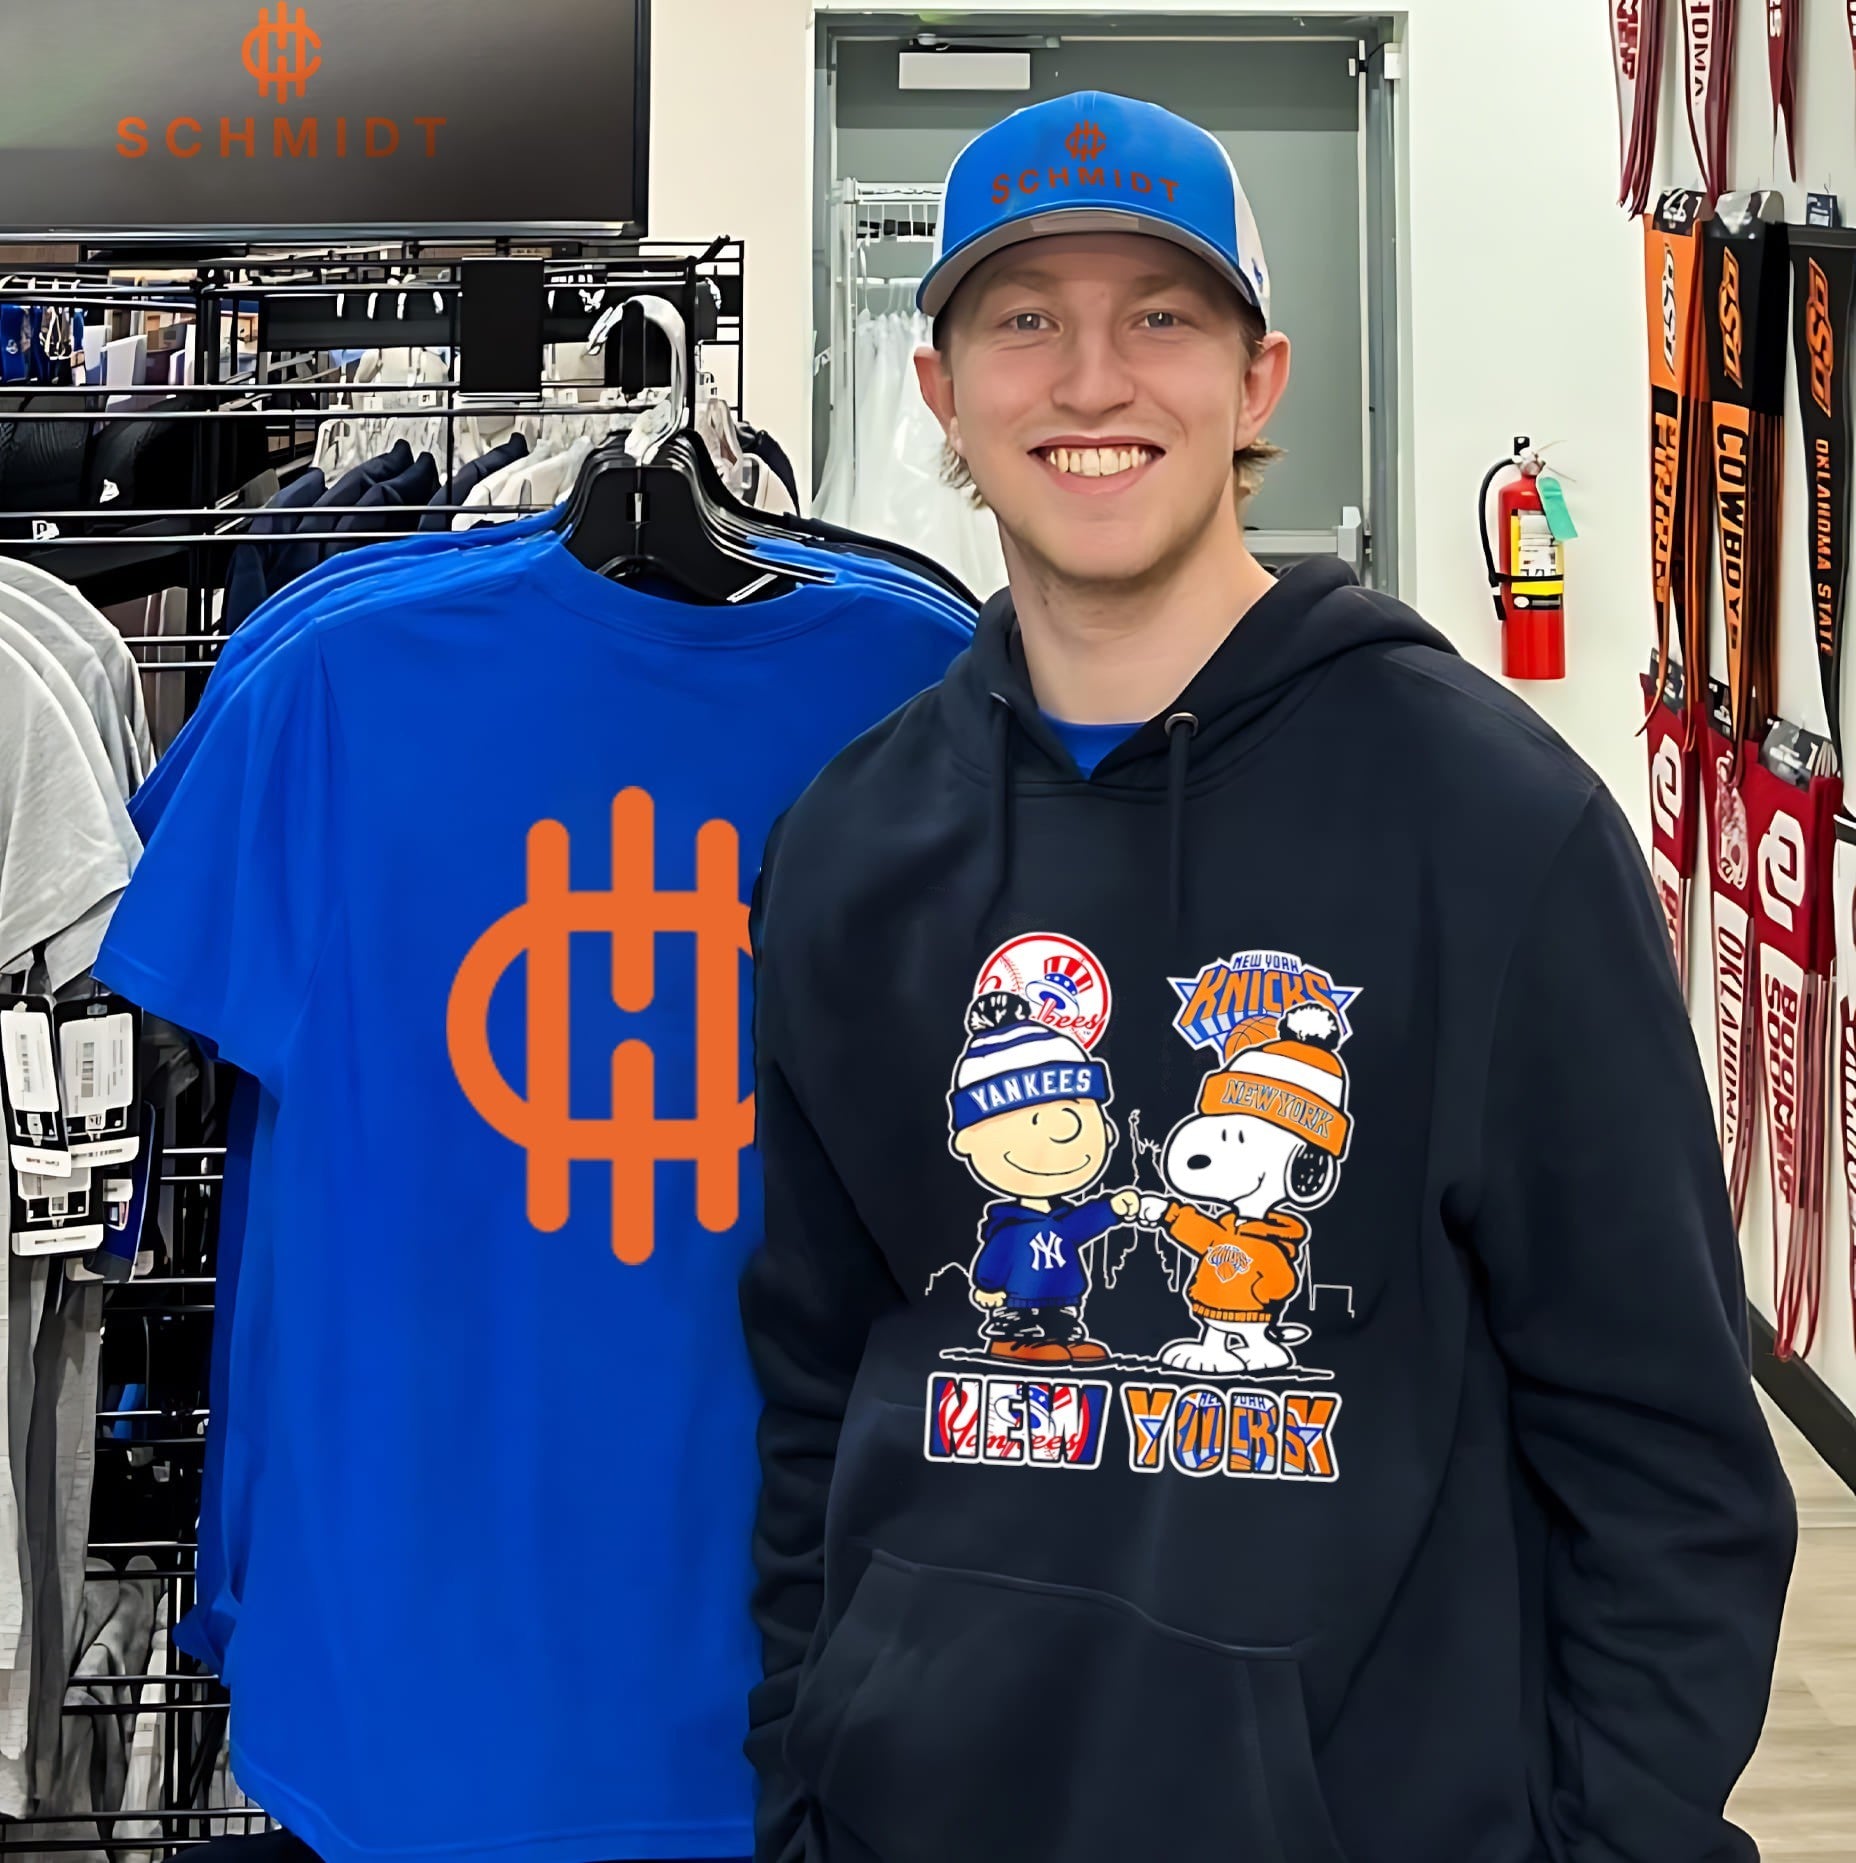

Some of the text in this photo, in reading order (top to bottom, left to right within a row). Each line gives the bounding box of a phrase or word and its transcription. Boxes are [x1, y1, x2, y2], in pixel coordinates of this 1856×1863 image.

[116, 116, 447, 158] SCHMIDT
[992, 167, 1178, 204] SCHMIDT
[1815, 439, 1832, 570] OKLAHOMA
[1232, 954, 1300, 973] NEW YORK
[1179, 966, 1340, 1030] KNICKS
[1718, 926, 1745, 1143] OKLAHOMA
[968, 1068, 1092, 1113] YANKEES
[1221, 1079, 1334, 1138] NEW YORK
[928, 1375, 1340, 1478] NEW YORK
[946, 1390, 1081, 1453] Yanees
